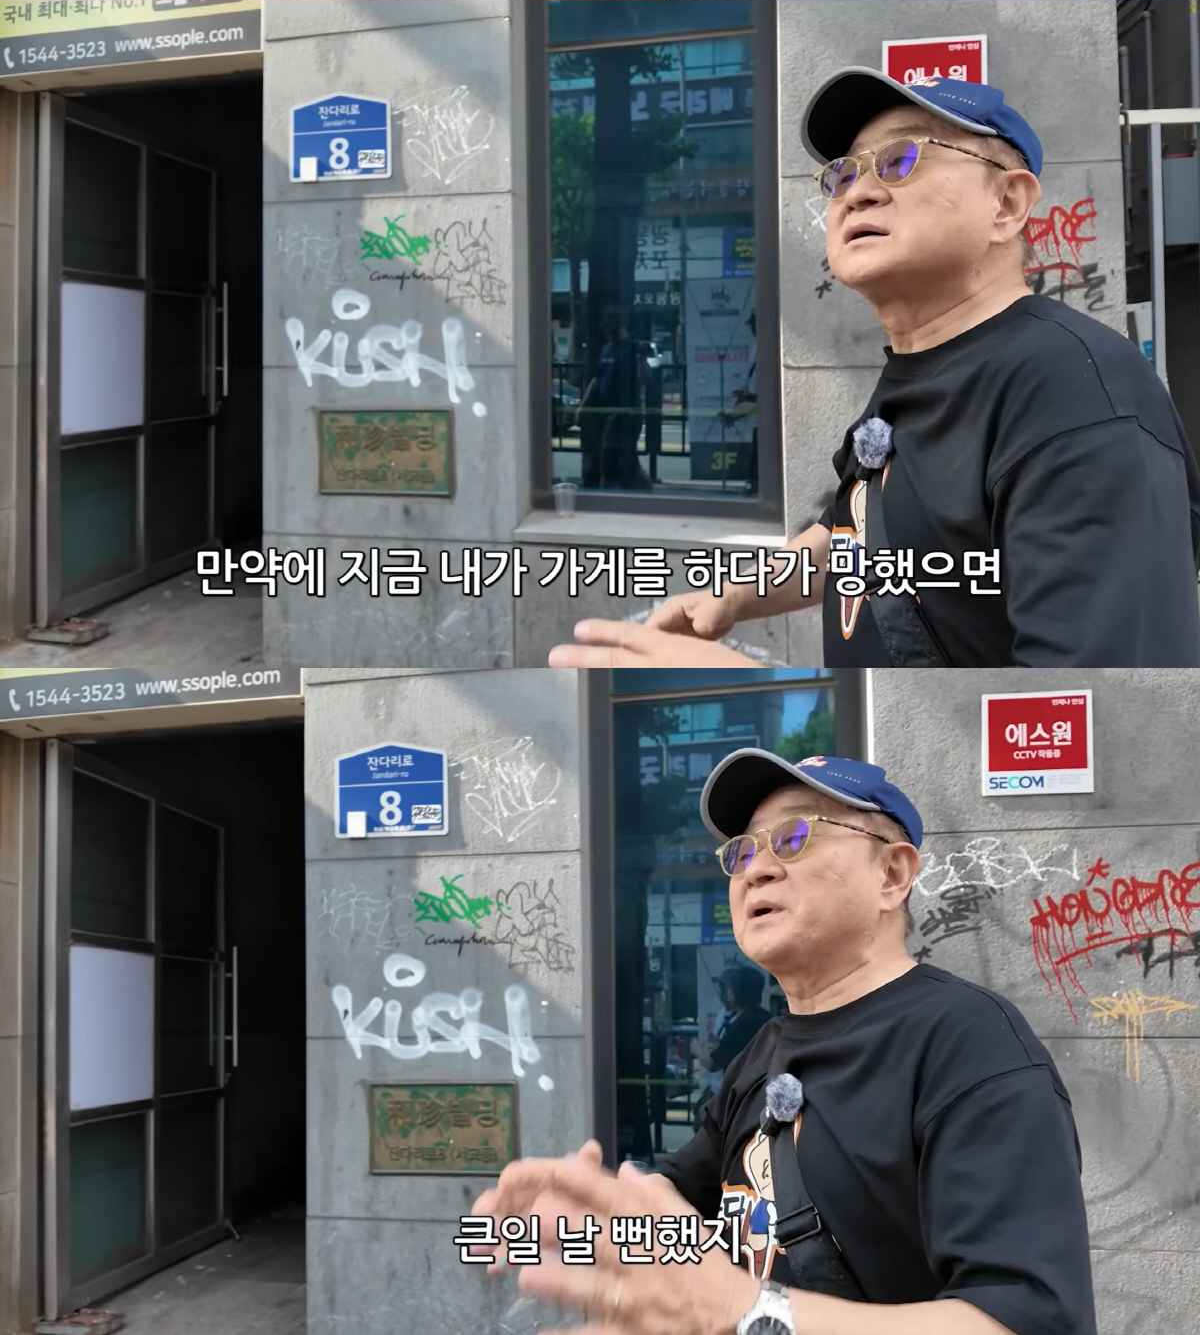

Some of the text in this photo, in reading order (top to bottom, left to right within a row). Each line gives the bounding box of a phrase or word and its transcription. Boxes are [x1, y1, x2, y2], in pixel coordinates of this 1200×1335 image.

[18, 25, 244, 64] 1544-3523 www.ssople.com
[318, 105, 361, 120] 잔다리로
[322, 119, 357, 128] Jandari-ro
[328, 137, 350, 170] 8
[711, 450, 738, 471] 3F
[25, 669, 281, 708] 1544-3523 www.ssople.com
[1004, 721, 1073, 748] 에스원
[366, 754, 415, 771] 잔다리로
[1012, 749, 1062, 760] CCTV 작동중
[371, 770, 410, 781] Jandari-ro
[988, 775, 1045, 790] SECOM
[379, 790, 403, 826] 8
